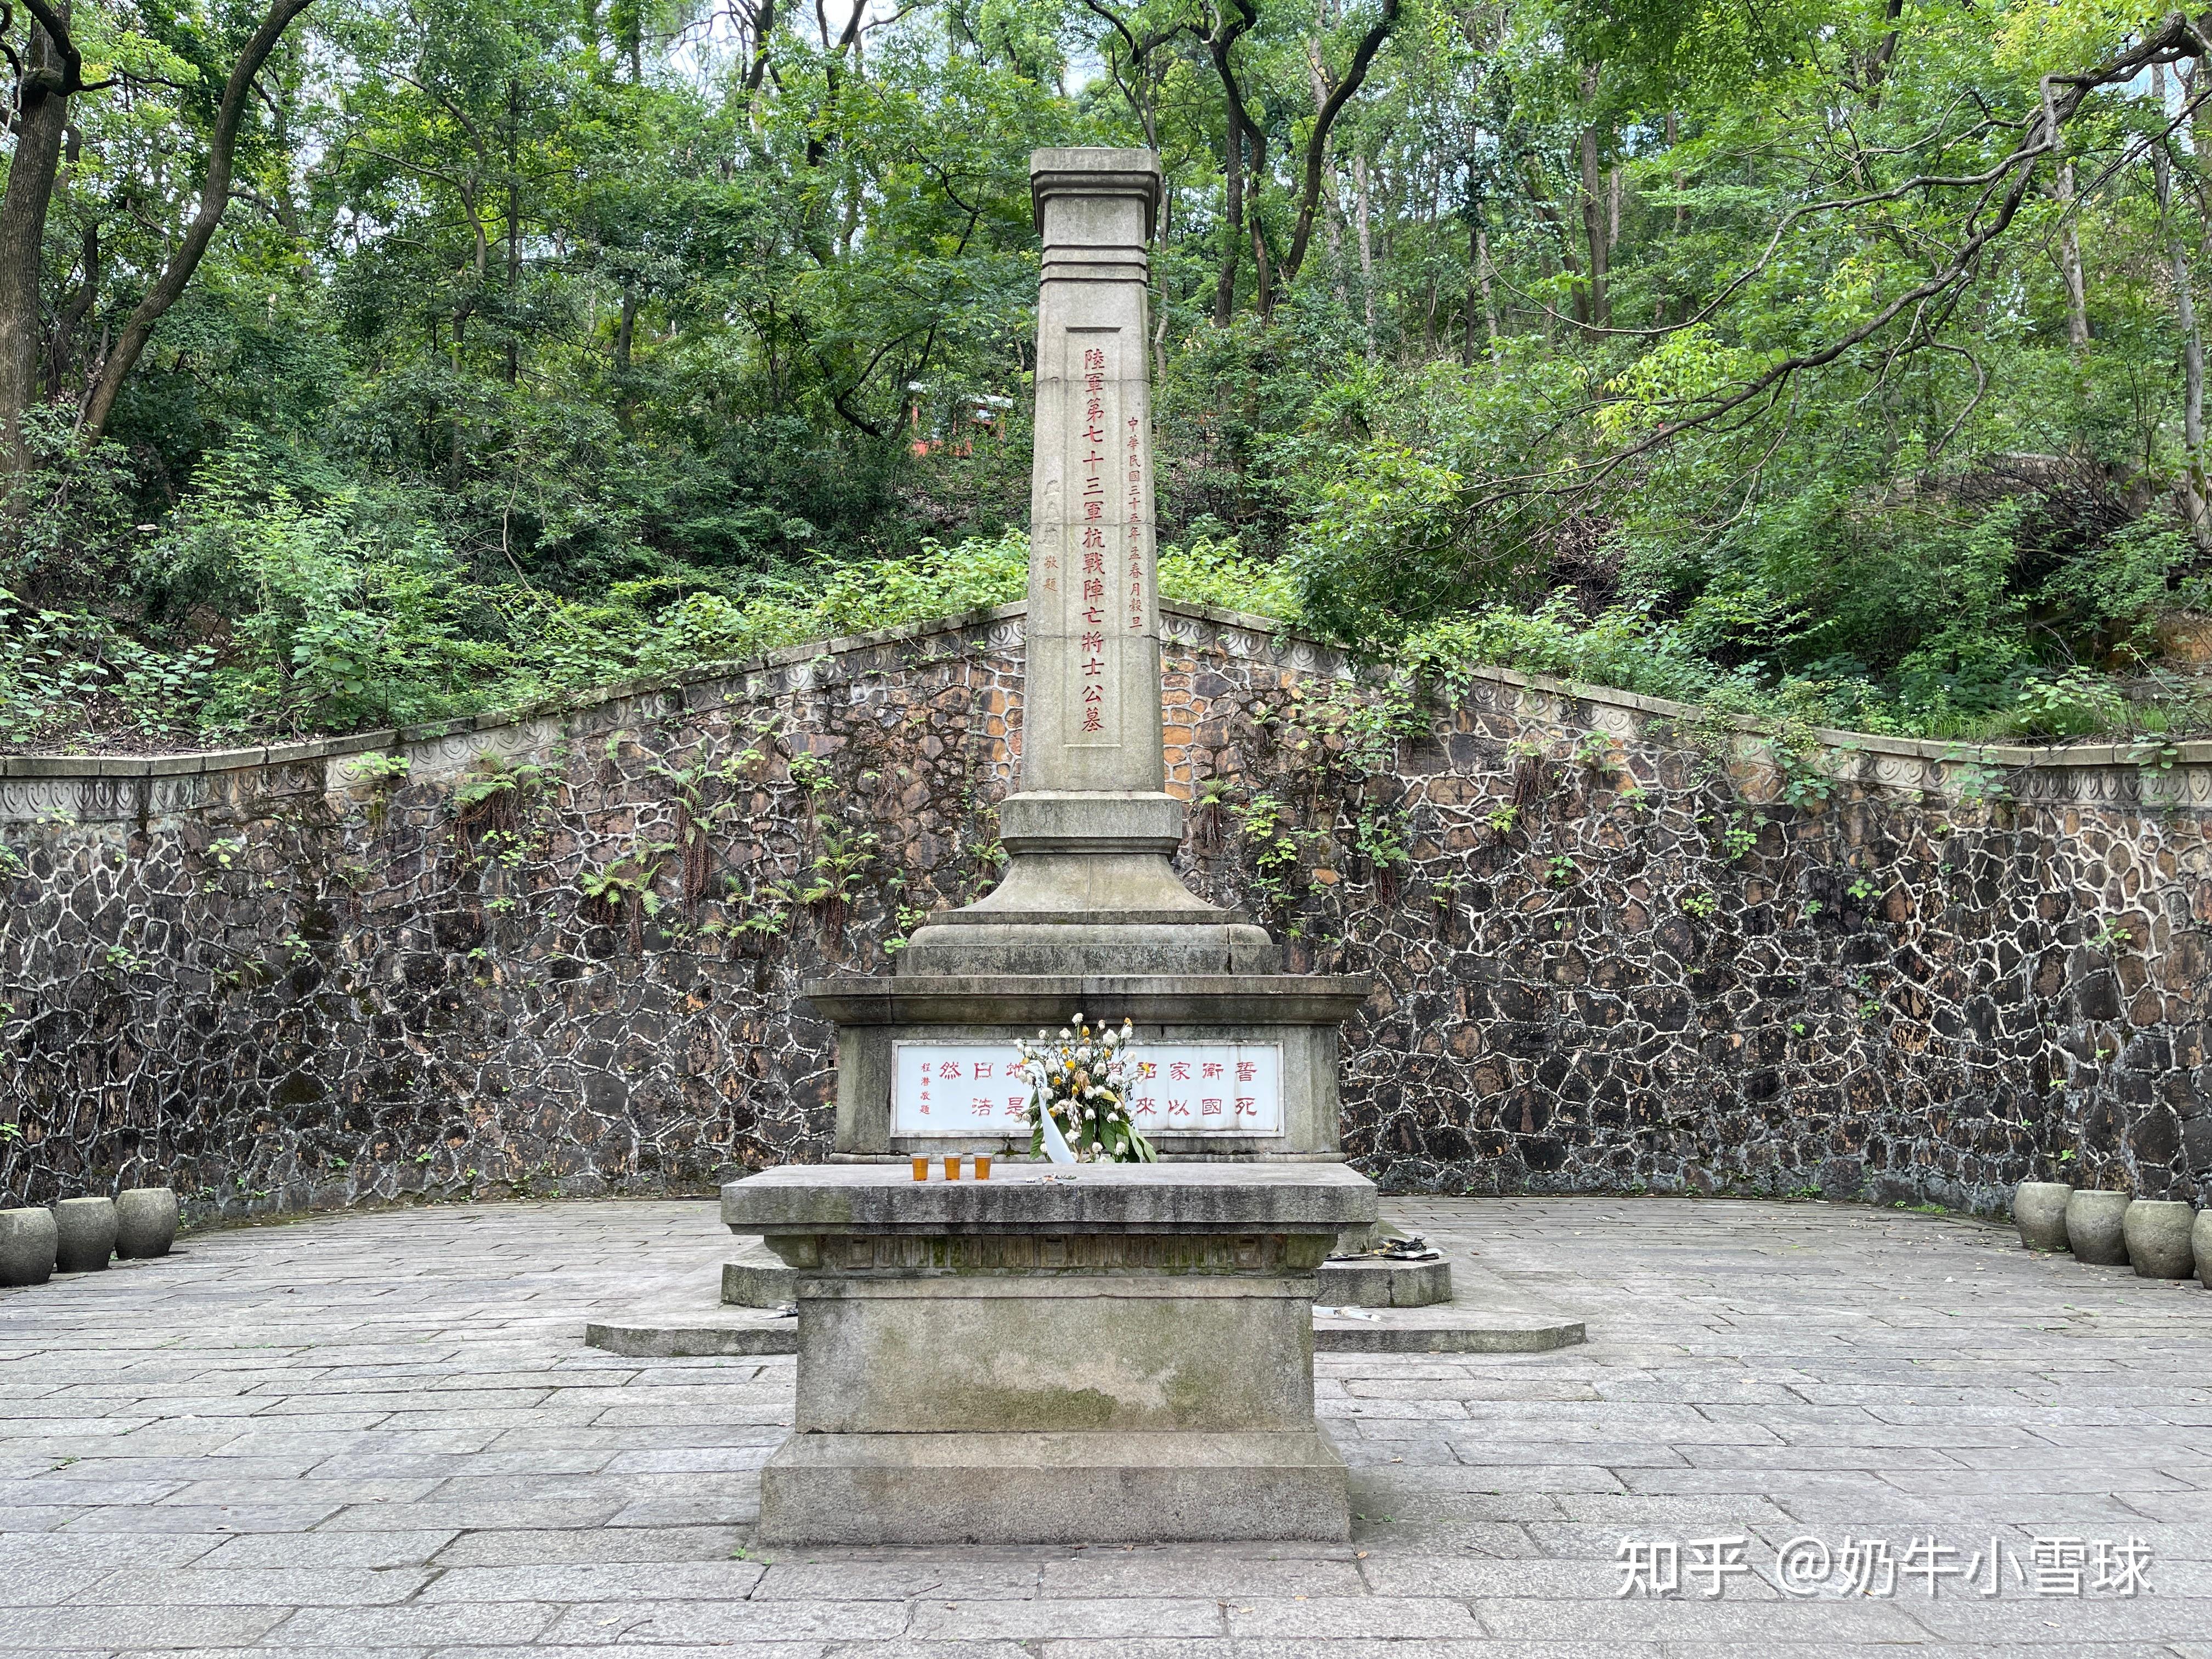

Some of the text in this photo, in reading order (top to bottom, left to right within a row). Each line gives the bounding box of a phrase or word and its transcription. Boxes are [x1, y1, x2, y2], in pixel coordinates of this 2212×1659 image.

[1081, 348, 1105, 732] 陸軍第七十三軍抗戰陣亡將士公墓
